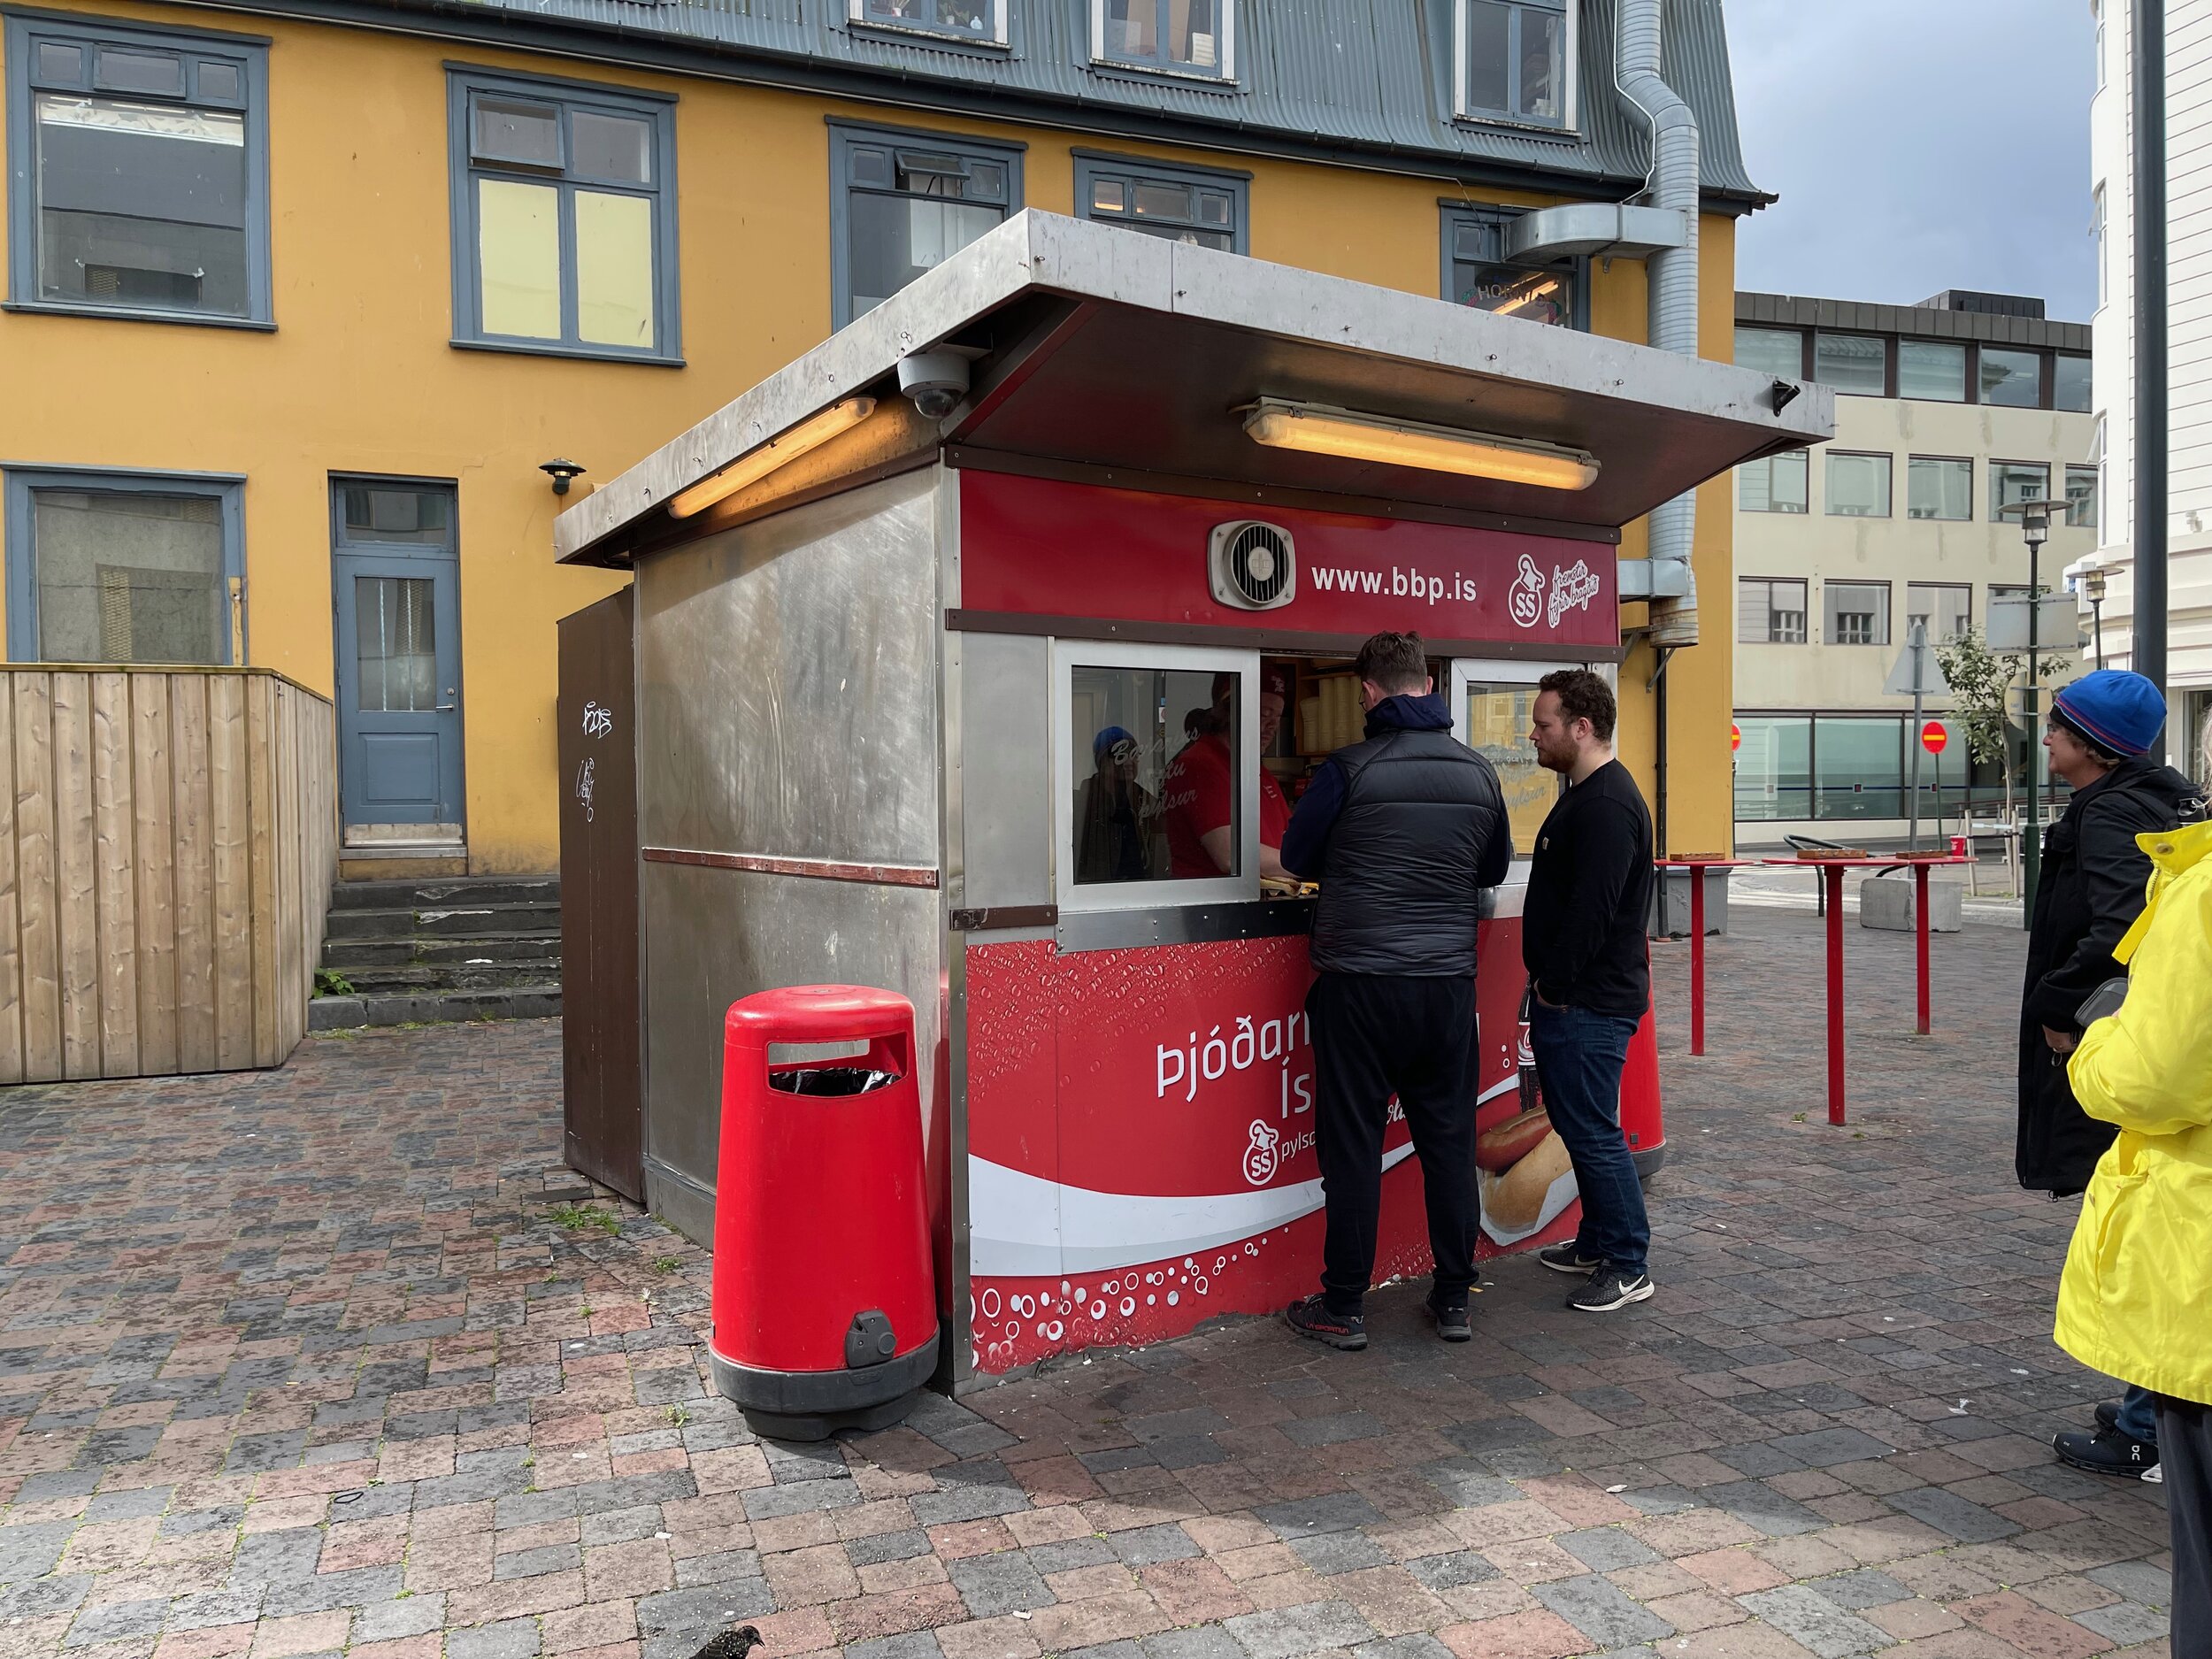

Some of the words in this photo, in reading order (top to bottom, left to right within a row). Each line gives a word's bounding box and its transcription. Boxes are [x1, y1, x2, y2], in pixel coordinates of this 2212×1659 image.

[1311, 566, 1477, 605] www.bbp.is
[1516, 592, 1536, 618] SS
[1282, 1056, 1311, 1119] Ís
[1250, 1151, 1271, 1178] SS
